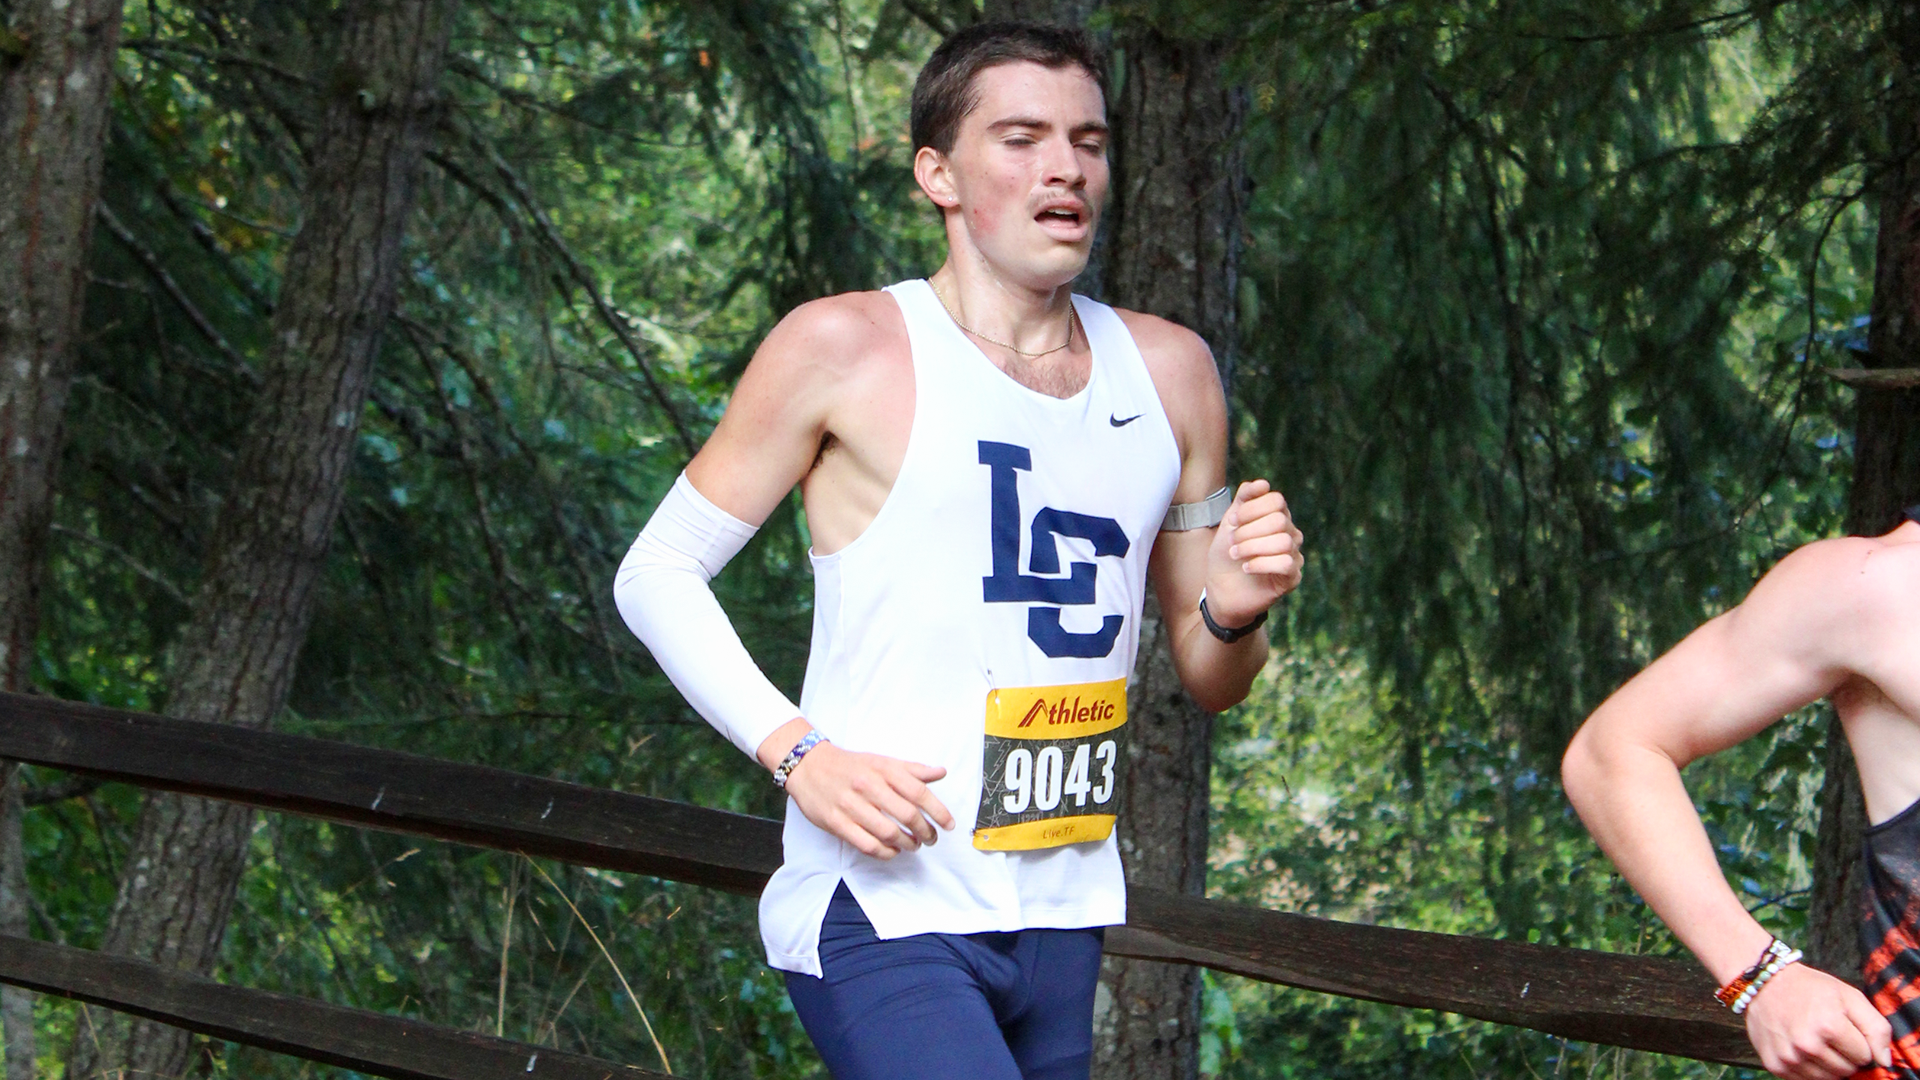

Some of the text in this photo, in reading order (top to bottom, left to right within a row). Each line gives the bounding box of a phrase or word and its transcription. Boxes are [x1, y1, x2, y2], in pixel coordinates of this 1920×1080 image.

[977, 440, 1130, 658] LC
[1017, 696, 1115, 728] Athletic
[1003, 740, 1117, 814] 9043
